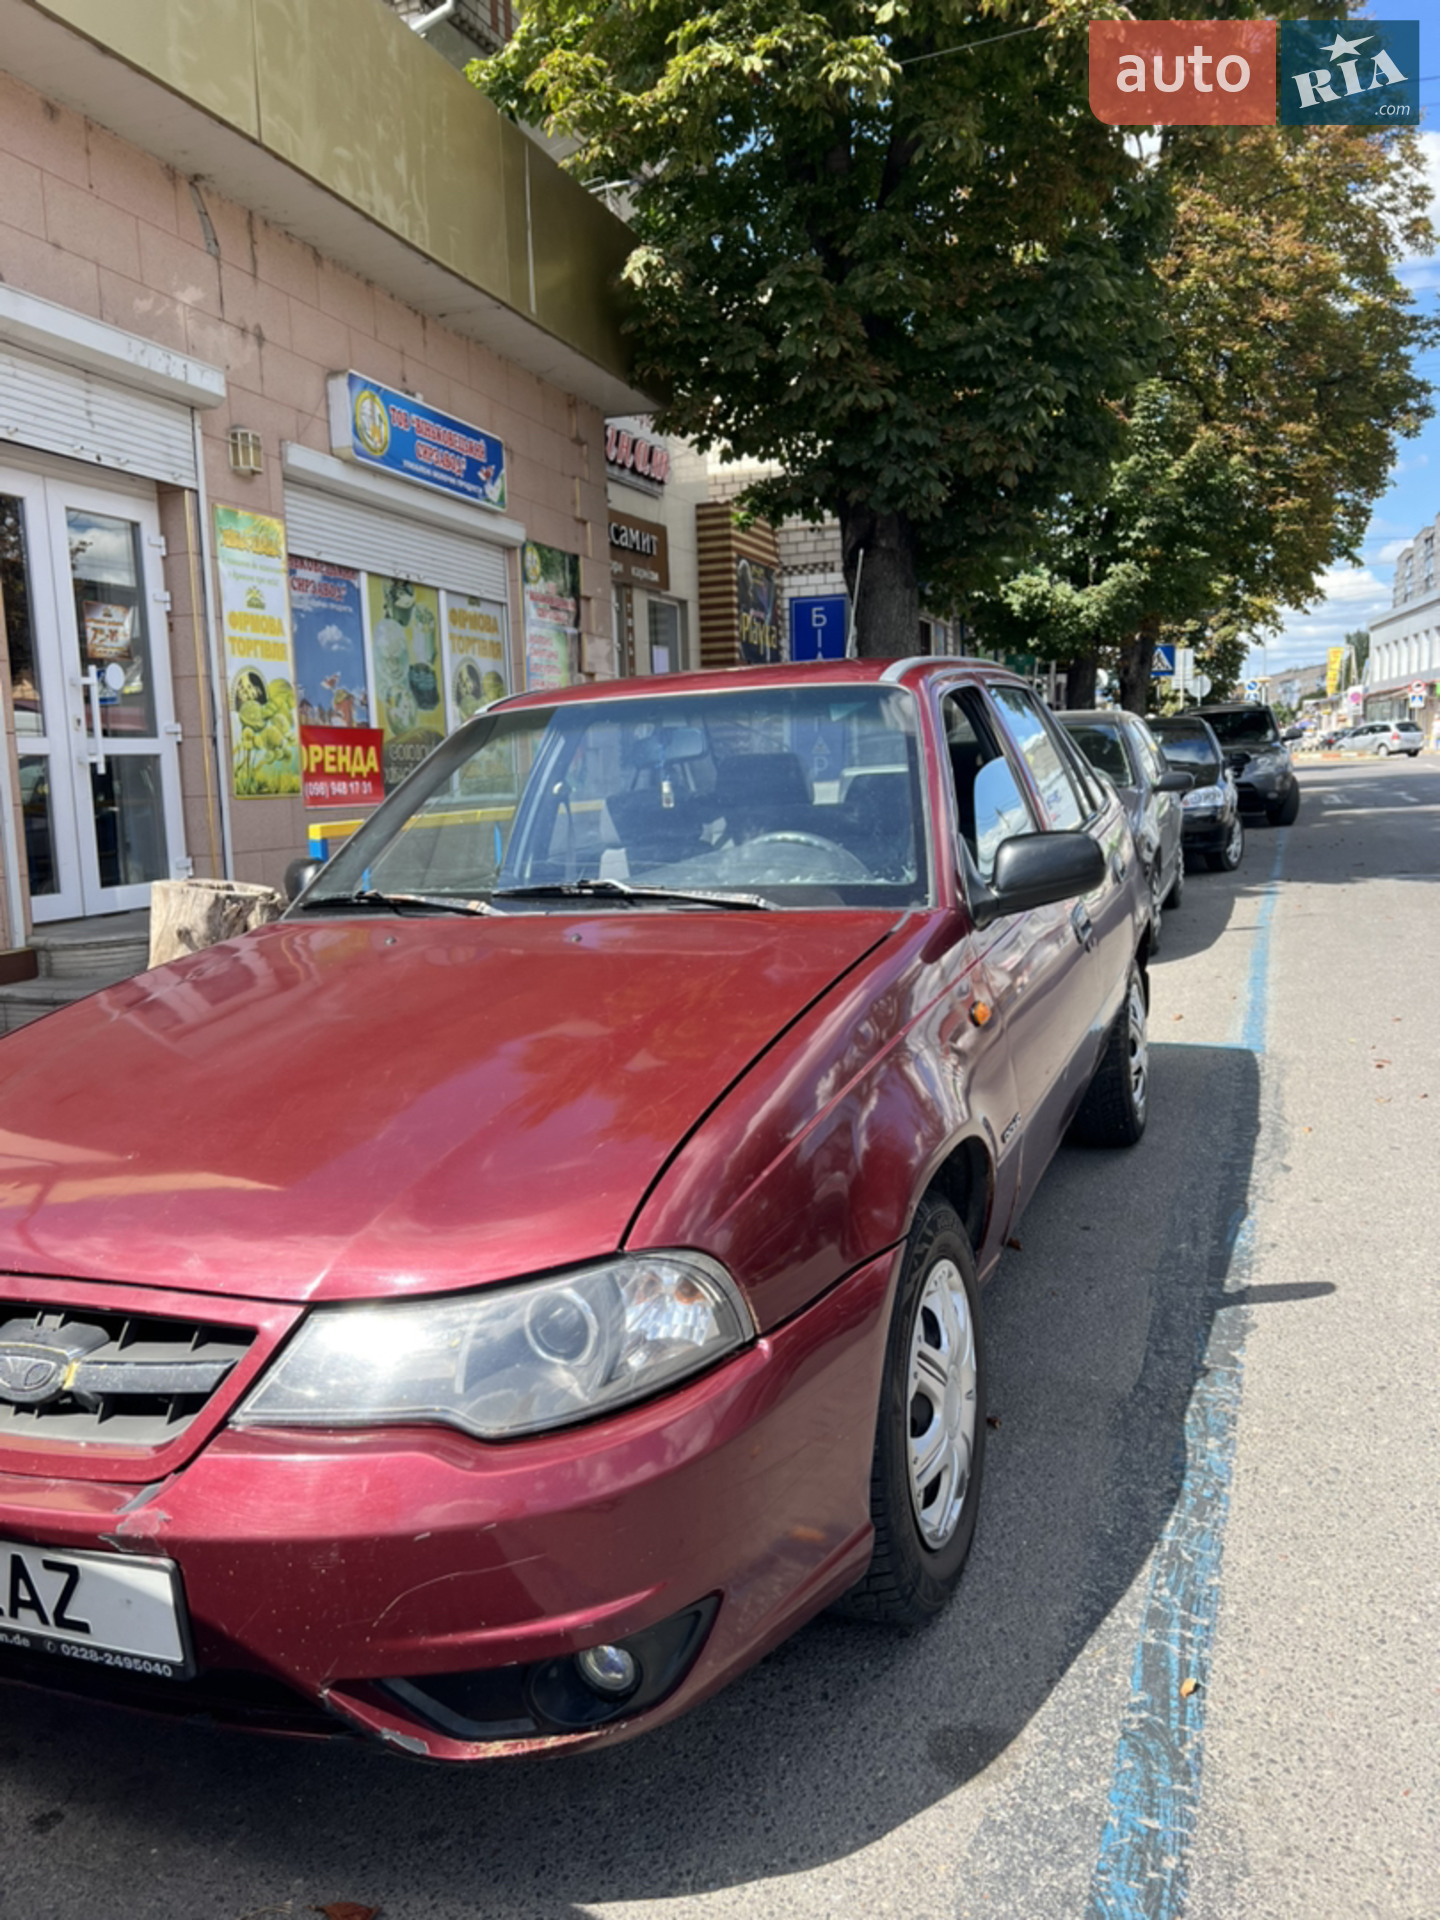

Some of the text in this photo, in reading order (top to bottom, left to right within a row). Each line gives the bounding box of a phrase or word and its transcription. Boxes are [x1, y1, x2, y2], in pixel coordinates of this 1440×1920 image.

[608, 521, 659, 556] самит
[227, 610, 285, 637] ФІРМОВА
[448, 606, 499, 634] ФІРМОВА
[227, 636, 287, 662] ТОРГІВЛЯ
[448, 631, 503, 661] ТОРГІВЛЯ
[348, 781, 361, 794] 17
